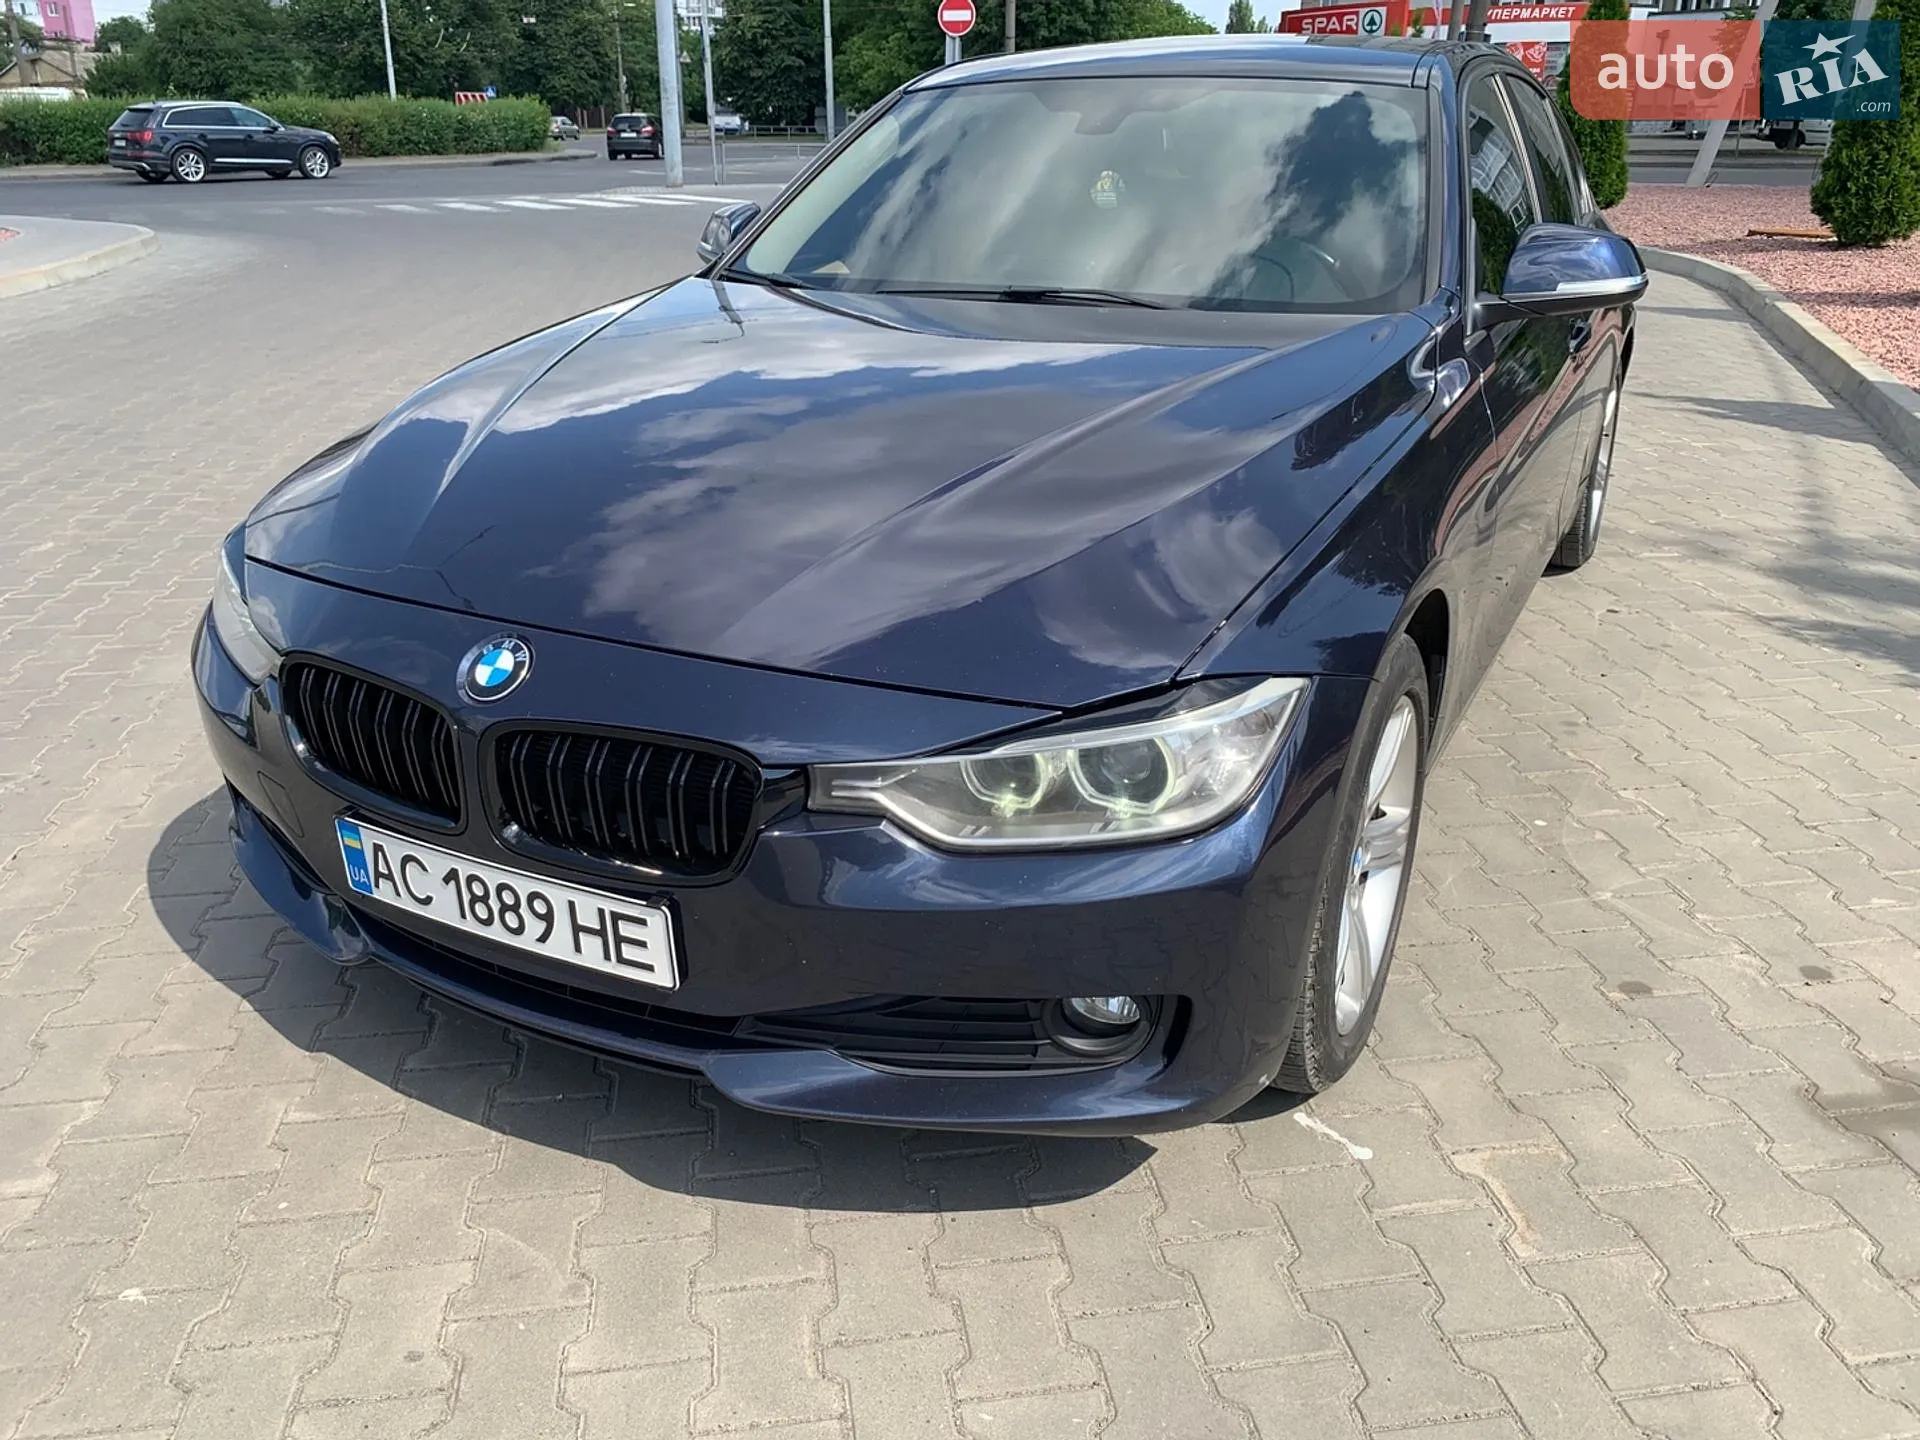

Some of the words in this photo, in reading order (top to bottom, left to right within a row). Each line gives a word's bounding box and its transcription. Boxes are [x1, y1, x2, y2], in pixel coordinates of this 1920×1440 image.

[1301, 15, 1357, 35] SPAR
[483, 640, 527, 662] BMW
[349, 863, 370, 886] UA
[373, 842, 433, 906] AC
[442, 867, 555, 943] 1889
[568, 899, 655, 973] HE
